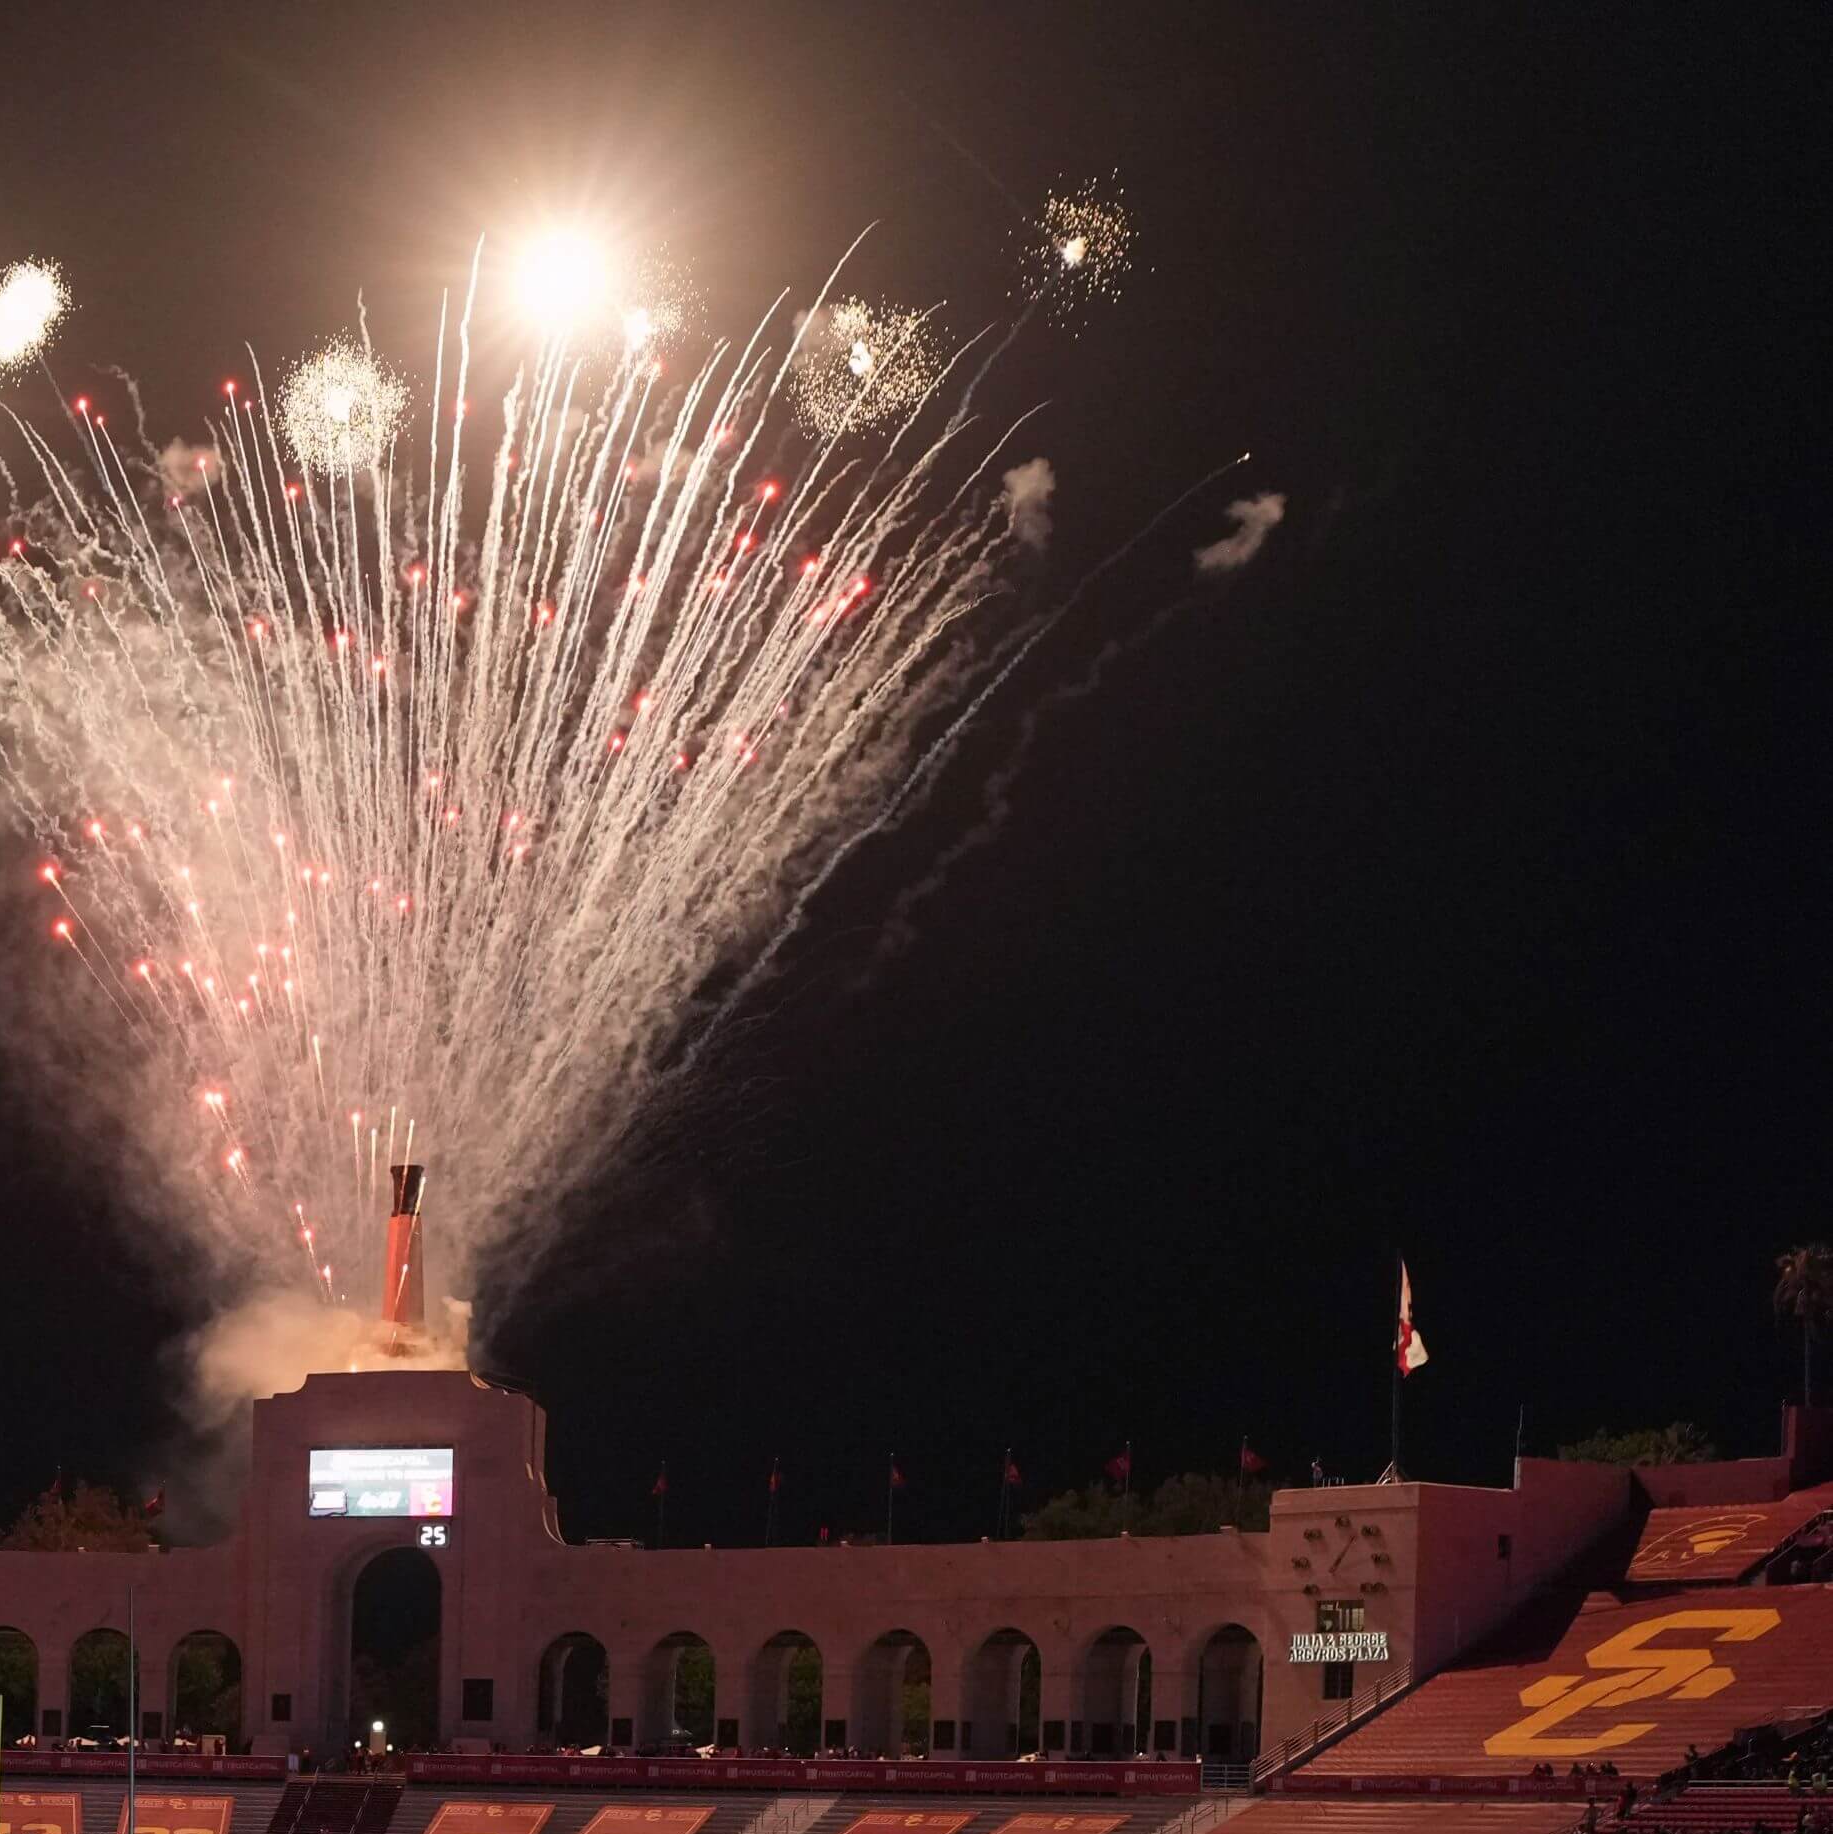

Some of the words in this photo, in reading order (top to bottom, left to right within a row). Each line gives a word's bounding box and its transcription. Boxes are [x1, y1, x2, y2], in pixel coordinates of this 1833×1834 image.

[420, 1526, 446, 1546] 25
[1291, 1633, 1324, 1648] JULIA
[1349, 1647, 1389, 1662] PLAZA
